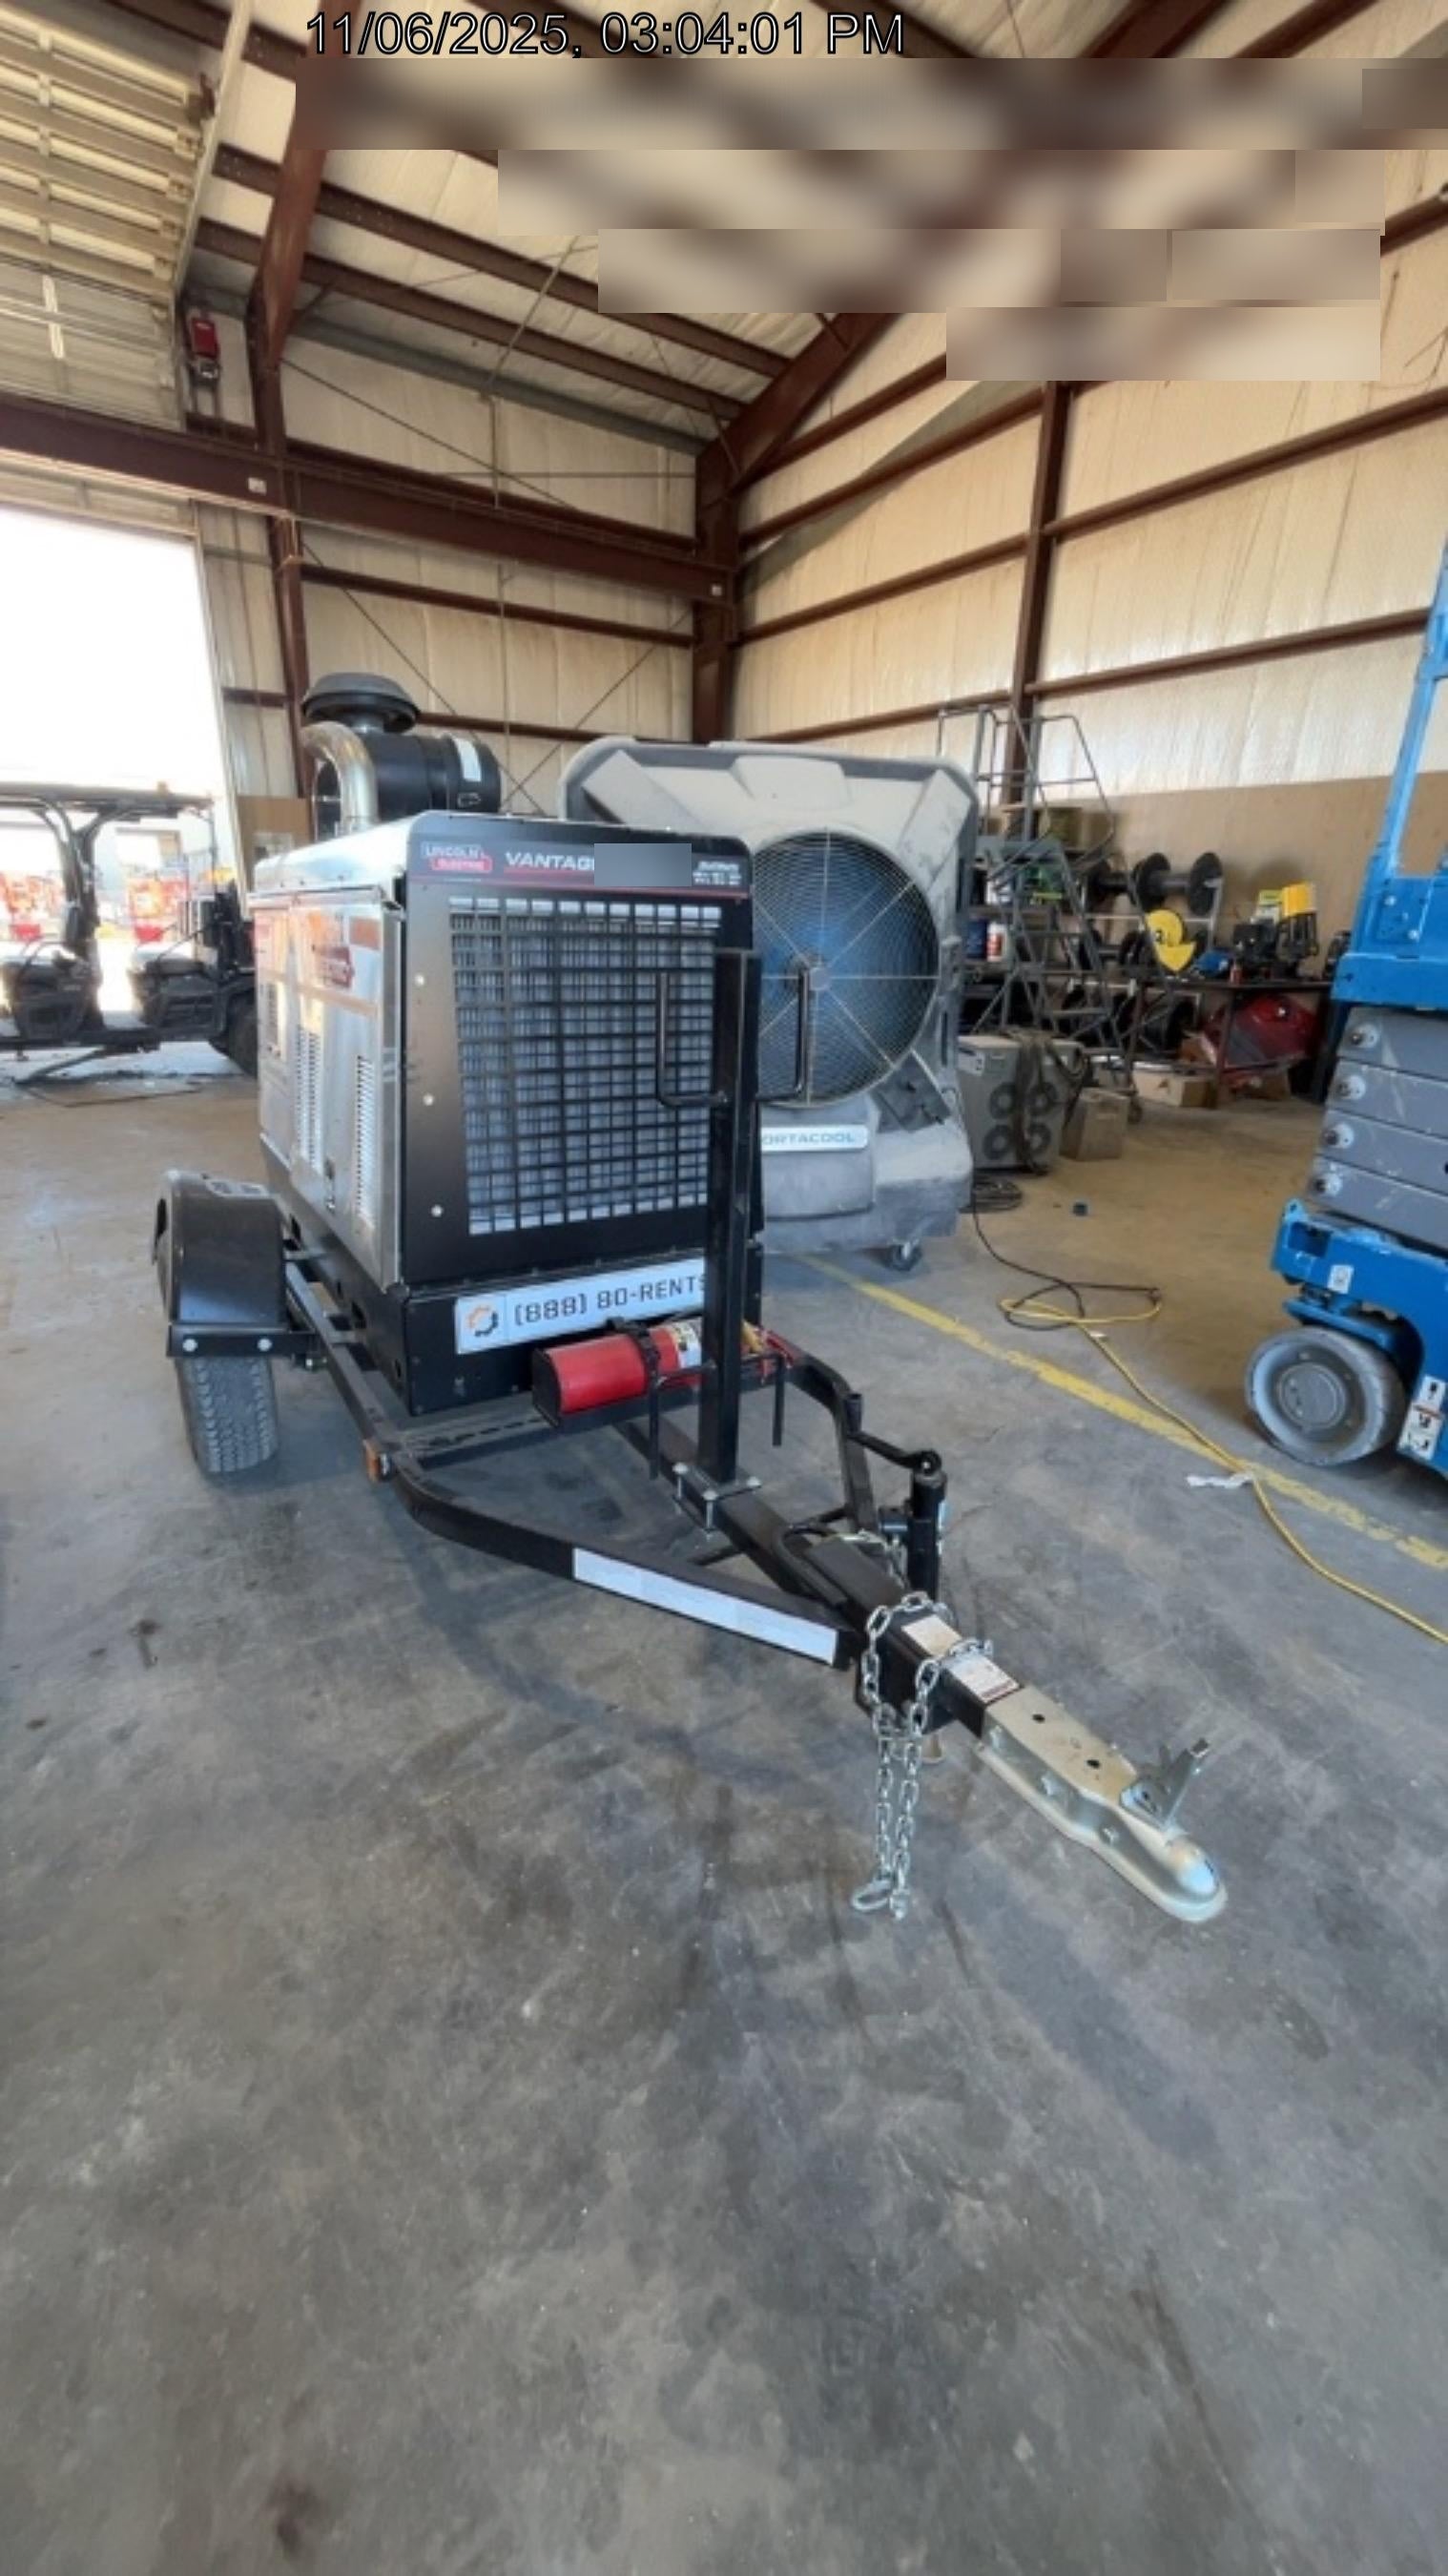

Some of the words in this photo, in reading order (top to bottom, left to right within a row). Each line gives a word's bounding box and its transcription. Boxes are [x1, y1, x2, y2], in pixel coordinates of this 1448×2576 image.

[505, 852, 595, 871] VANTAG
[761, 1132, 856, 1146] ORTACOOL
[514, 1294, 588, 1325] (888)
